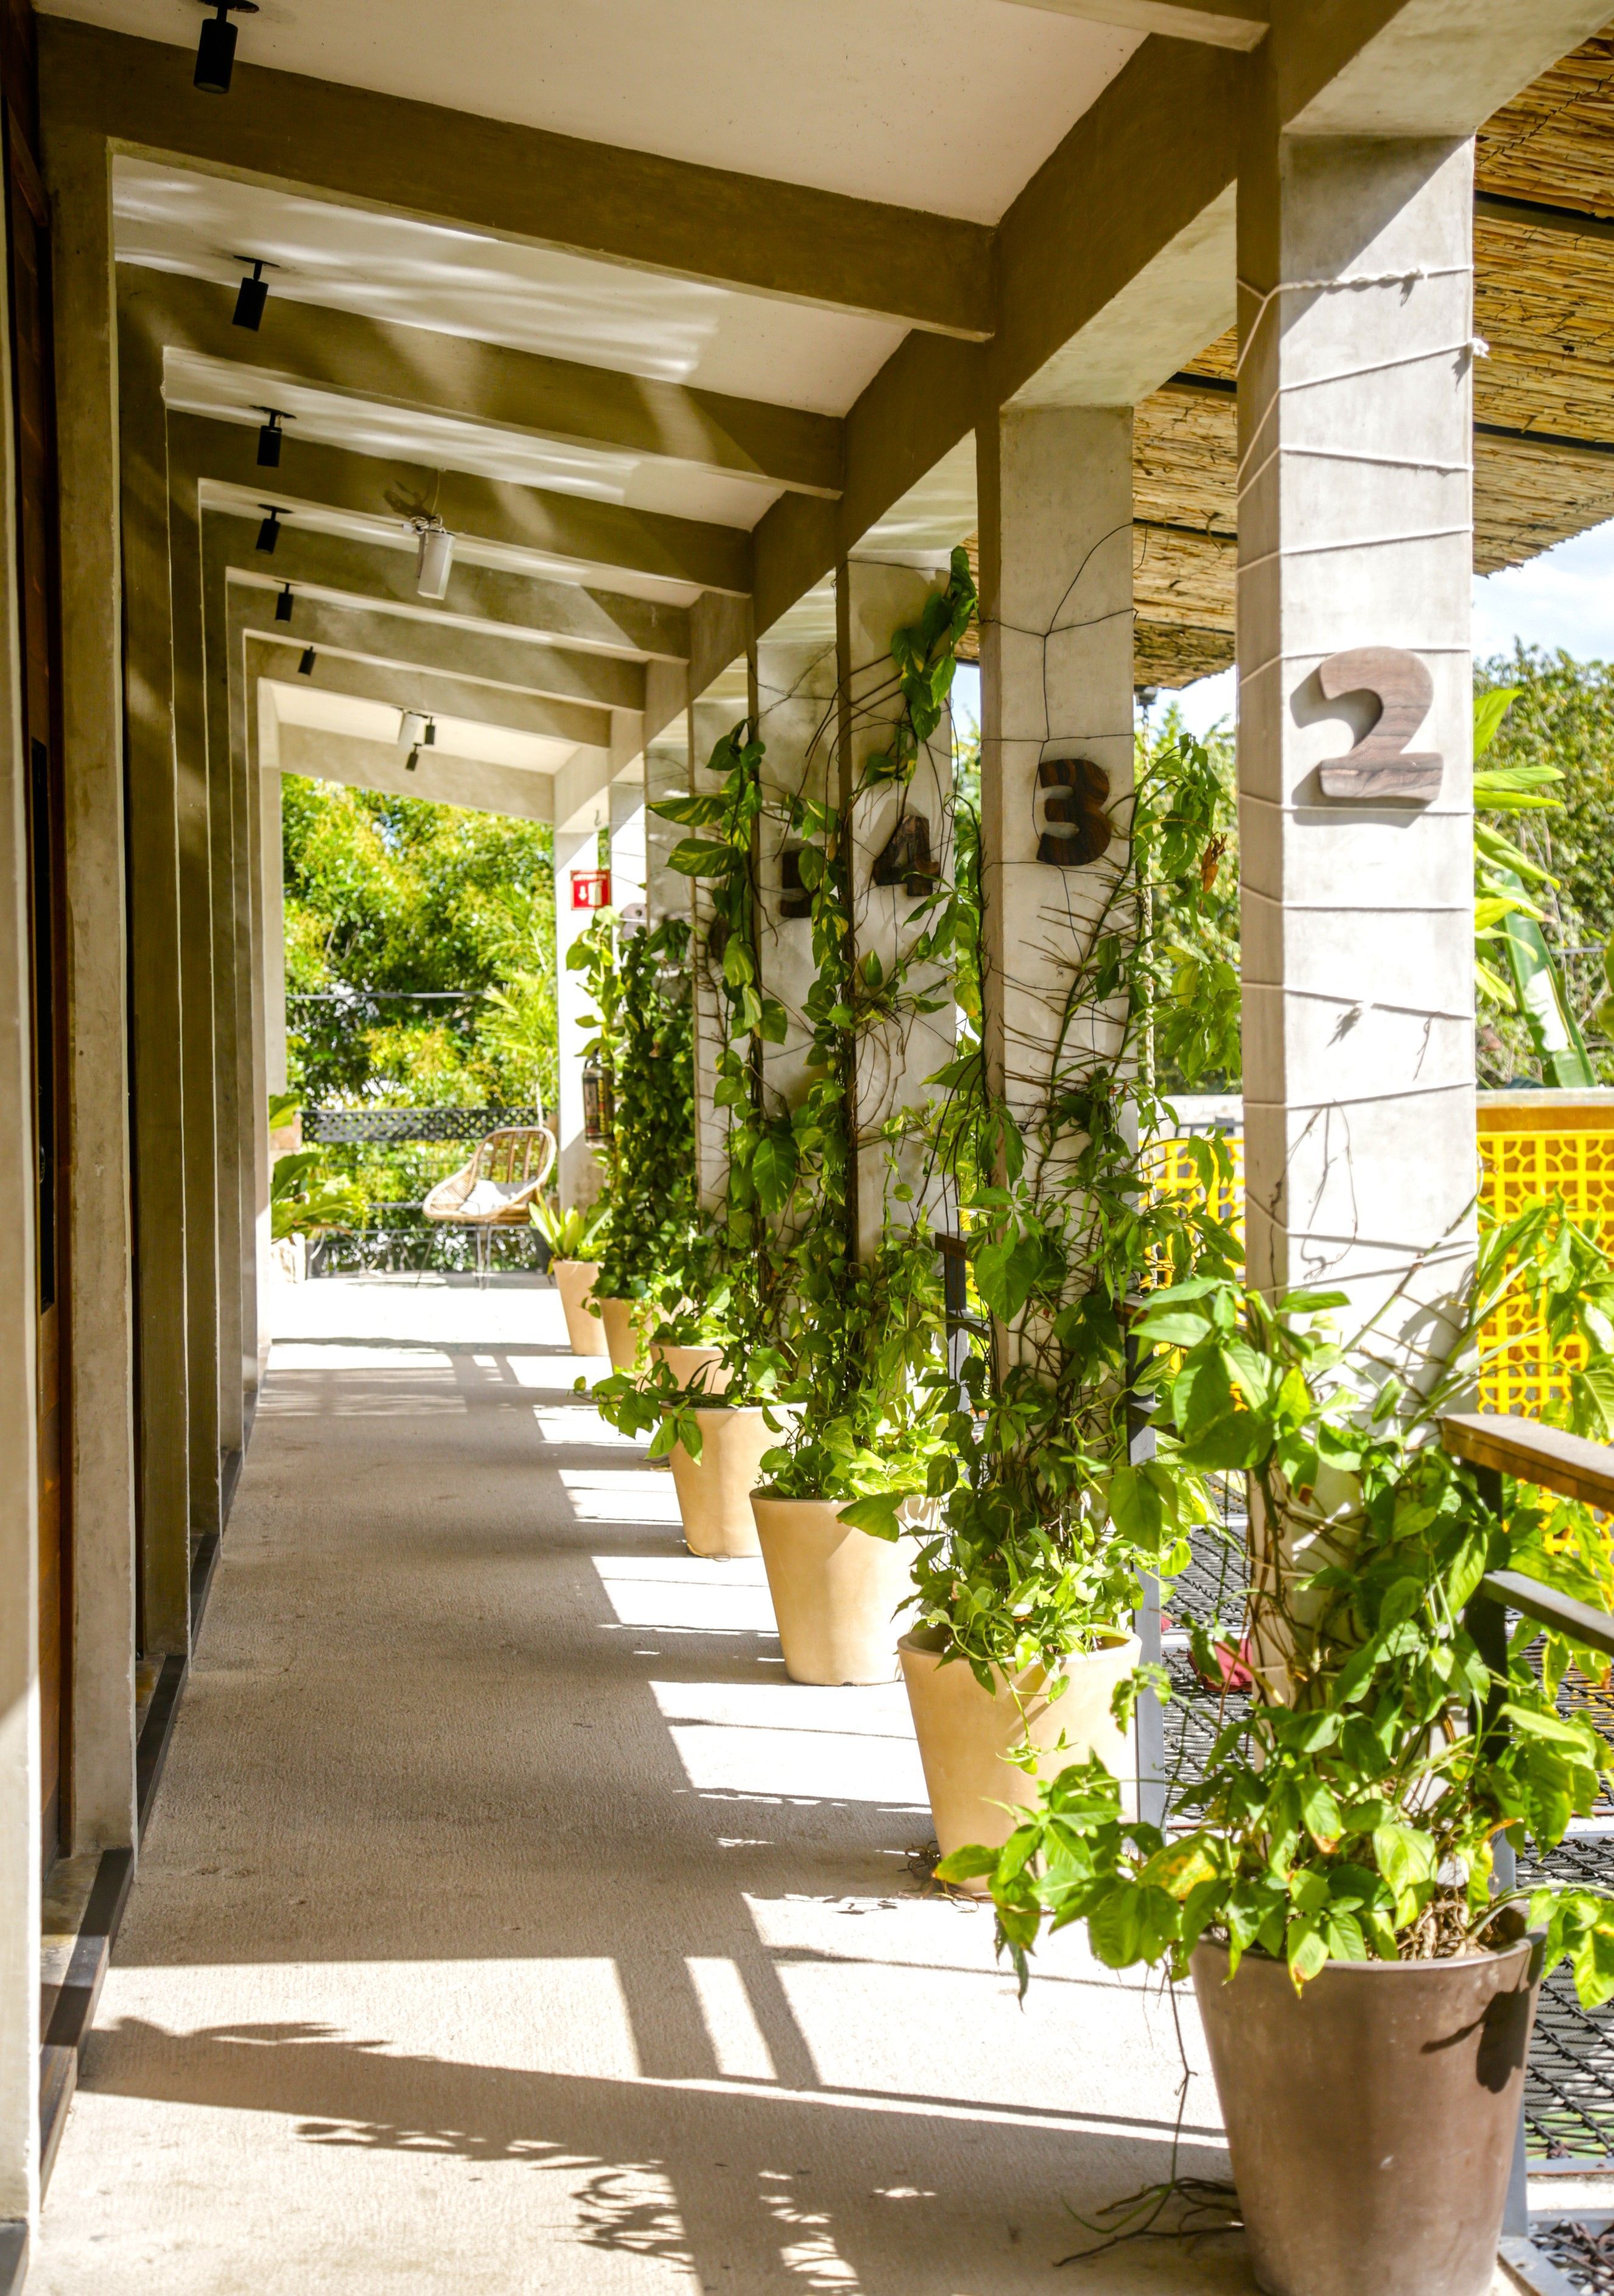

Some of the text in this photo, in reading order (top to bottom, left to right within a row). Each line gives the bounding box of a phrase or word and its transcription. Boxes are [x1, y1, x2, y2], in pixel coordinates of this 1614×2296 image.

[1319, 645, 1444, 802] 2
[872, 814, 941, 897] 4
[1036, 758, 1112, 866] 3
